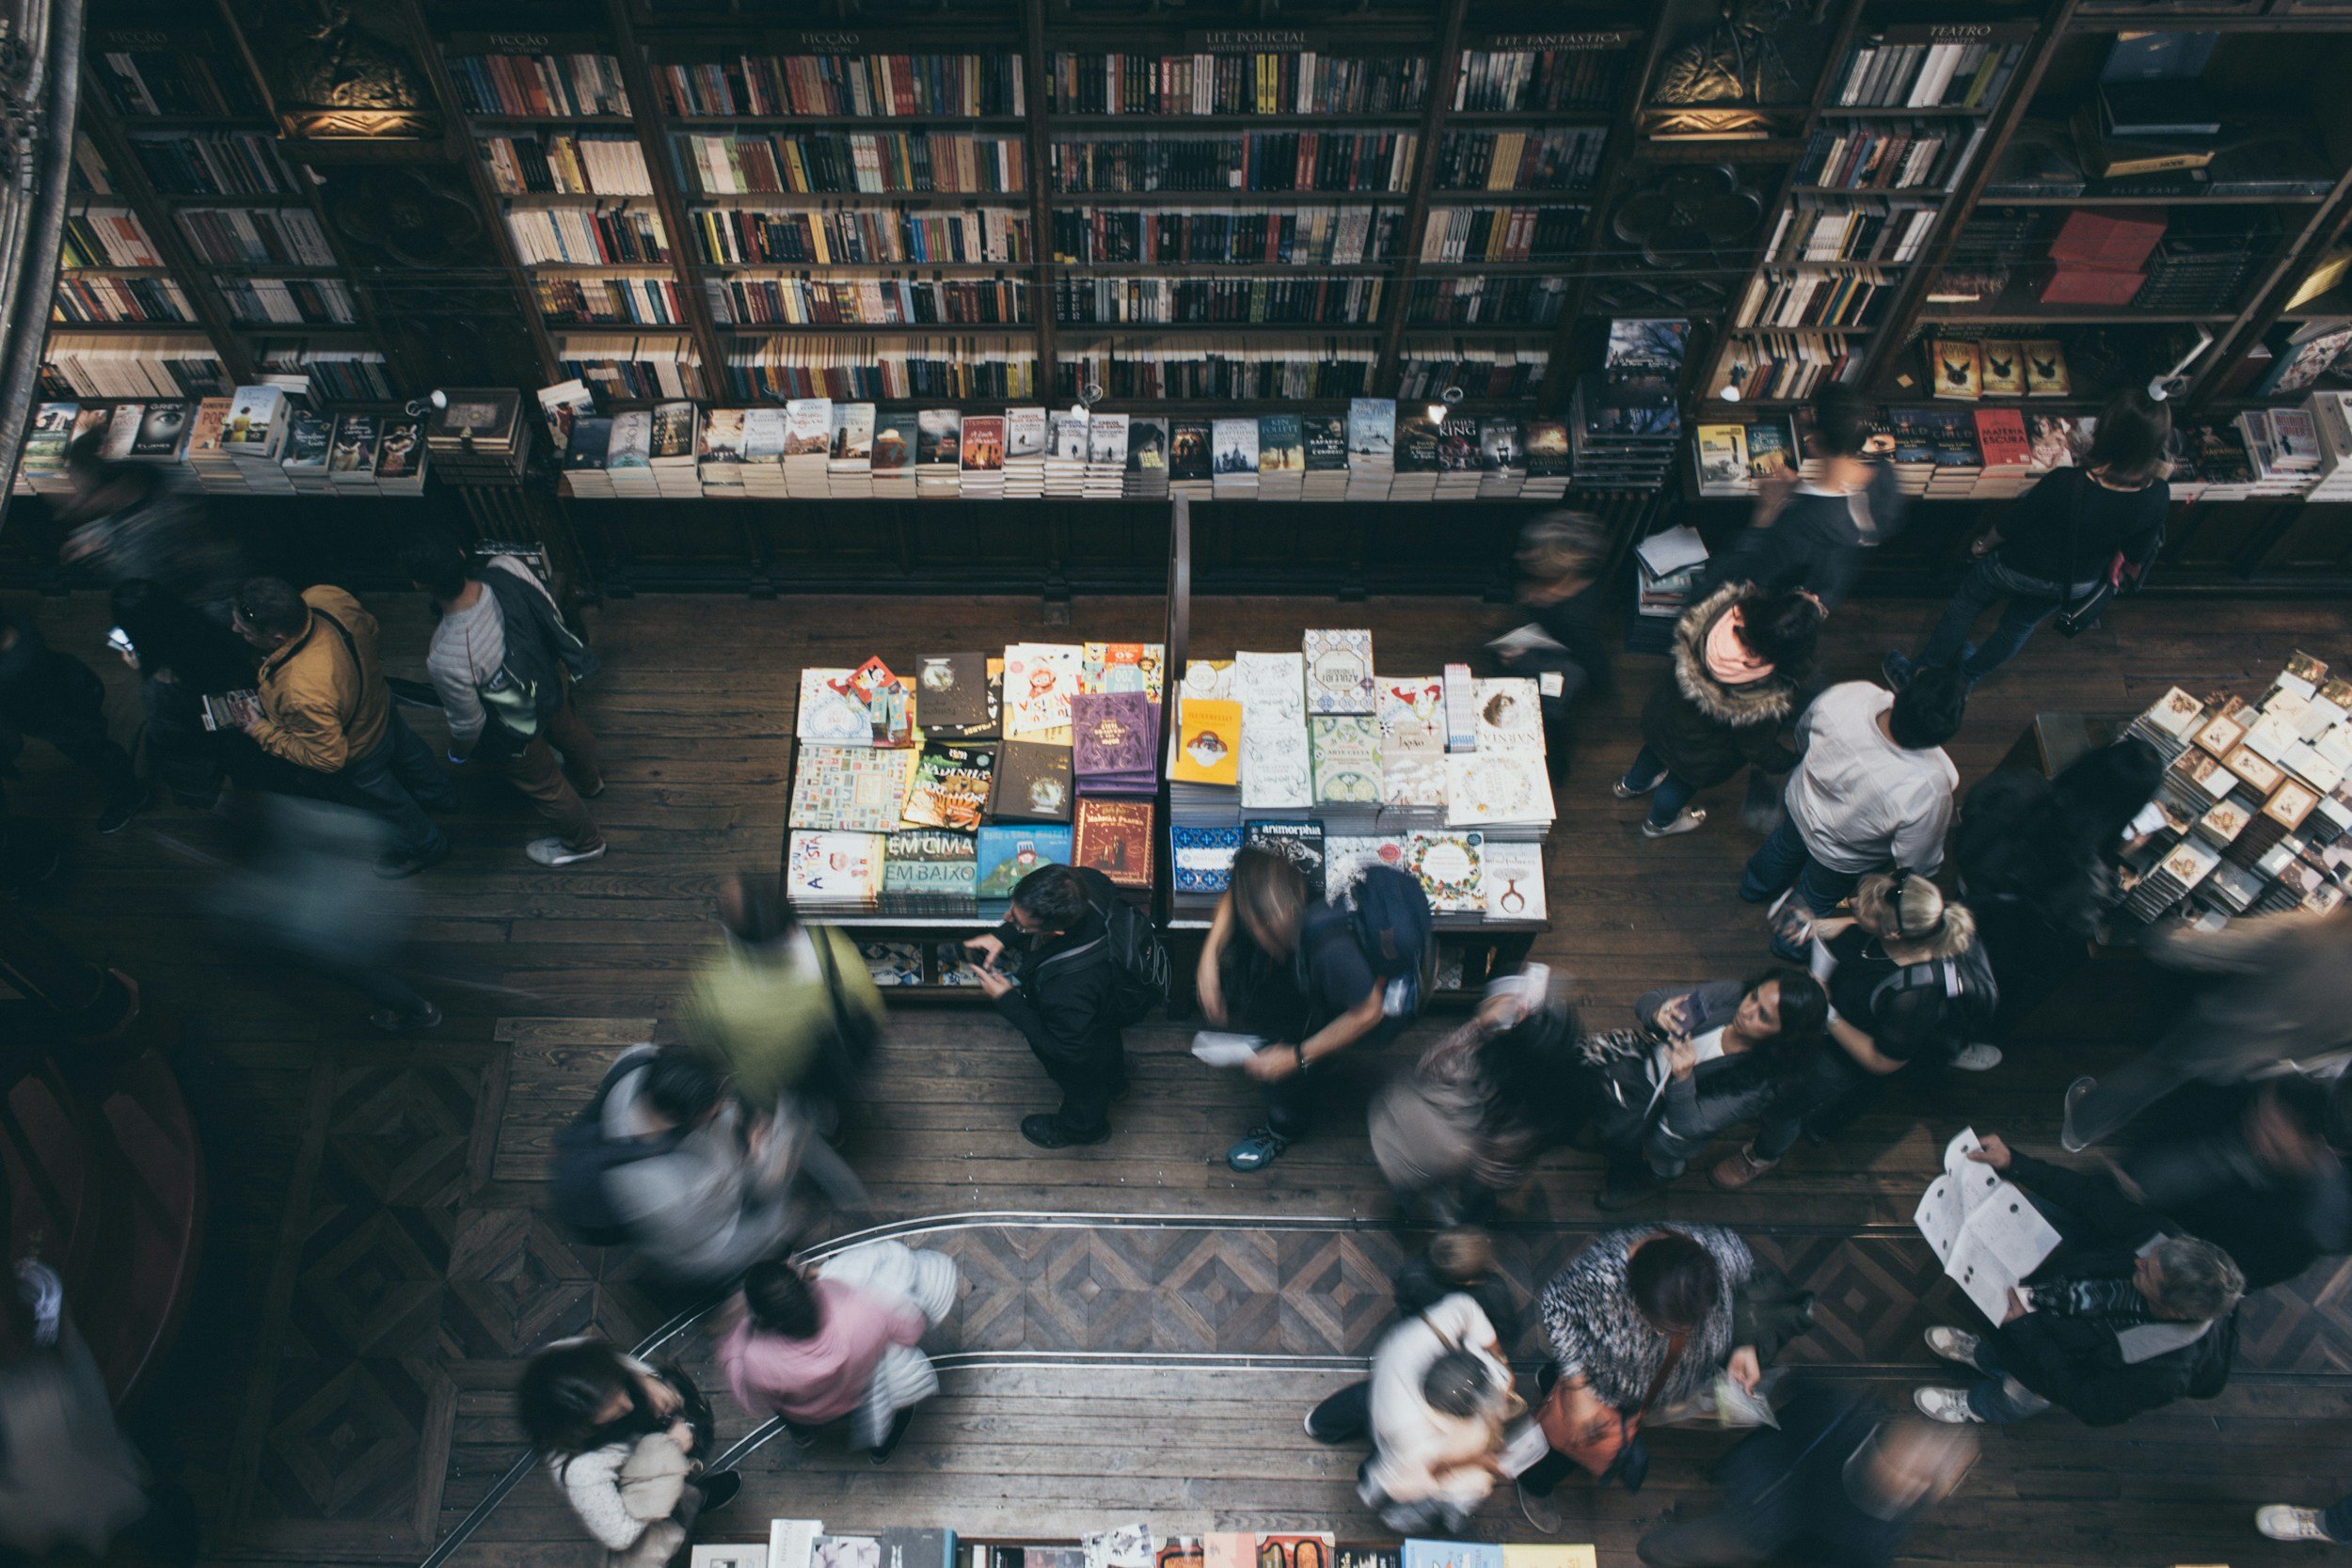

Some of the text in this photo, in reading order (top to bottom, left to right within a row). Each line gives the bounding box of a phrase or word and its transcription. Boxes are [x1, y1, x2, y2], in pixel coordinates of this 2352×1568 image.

[1236, 31, 1306, 43] POLICIAL
[1930, 24, 1991, 37] TEATRO
[490, 34, 548, 47] FICÇÃO
[802, 32, 860, 46] FICÇÃO
[1439, 427, 1477, 436] KING
[1932, 429, 1973, 438] CHILD
[1984, 436, 2027, 446] ESCURA
[963, 722, 992, 736] GRANDE
[1483, 733, 1535, 742] NARNIA
[1262, 824, 1322, 836] animorphia
[888, 837, 974, 855] EM CIMA
[792, 852, 803, 871] SOU
[803, 835, 823, 889] ARTISTA
[796, 873, 805, 885] EU
[886, 865, 976, 880] EM BAIXO
